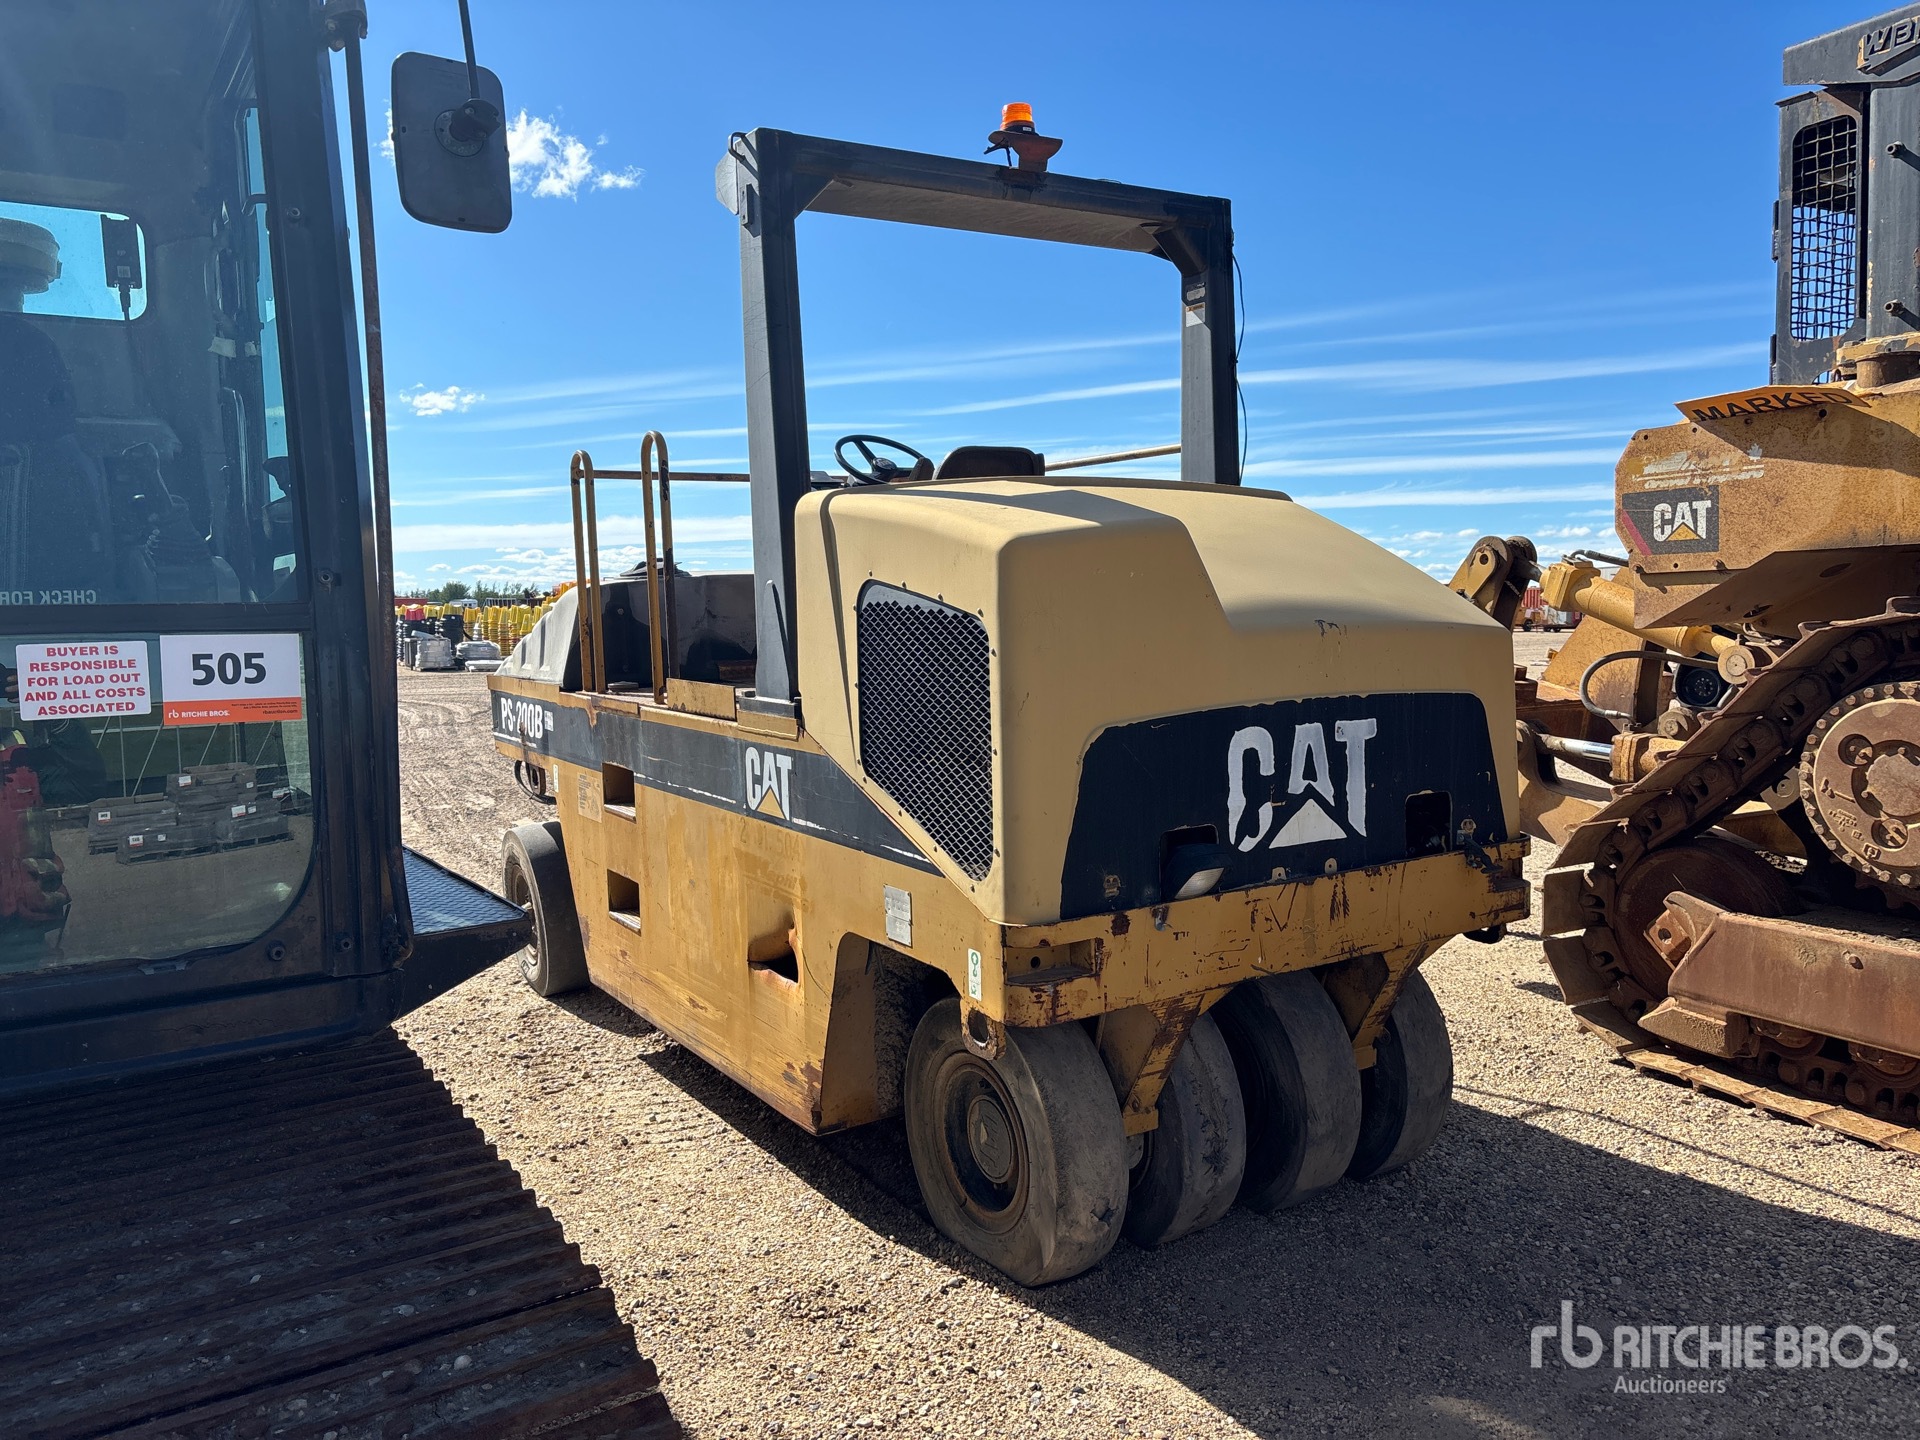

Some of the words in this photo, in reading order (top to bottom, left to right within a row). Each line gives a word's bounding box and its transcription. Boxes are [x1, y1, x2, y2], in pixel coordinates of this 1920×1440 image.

[1858, 16, 1920, 64] WB
[1692, 391, 1853, 422] MARKED
[1653, 500, 1712, 542] CAT
[29, 659, 137, 672] RESPONSIBLE
[46, 646, 99, 657] BUYER
[104, 645, 119, 655] IS
[27, 677, 59, 687] FOR
[63, 675, 105, 685] LOAD
[109, 673, 141, 683] OUT
[192, 652, 267, 686] 505
[24, 691, 58, 702] AND
[62, 690, 91, 700] ALL
[95, 687, 146, 699] COSTS
[37, 702, 136, 716] ASSOCIATED
[181, 710, 209, 718] RITCHIE
[500, 697, 544, 739] PS-200B
[745, 746, 793, 821] CAT
[1226, 717, 1377, 852] CAT
